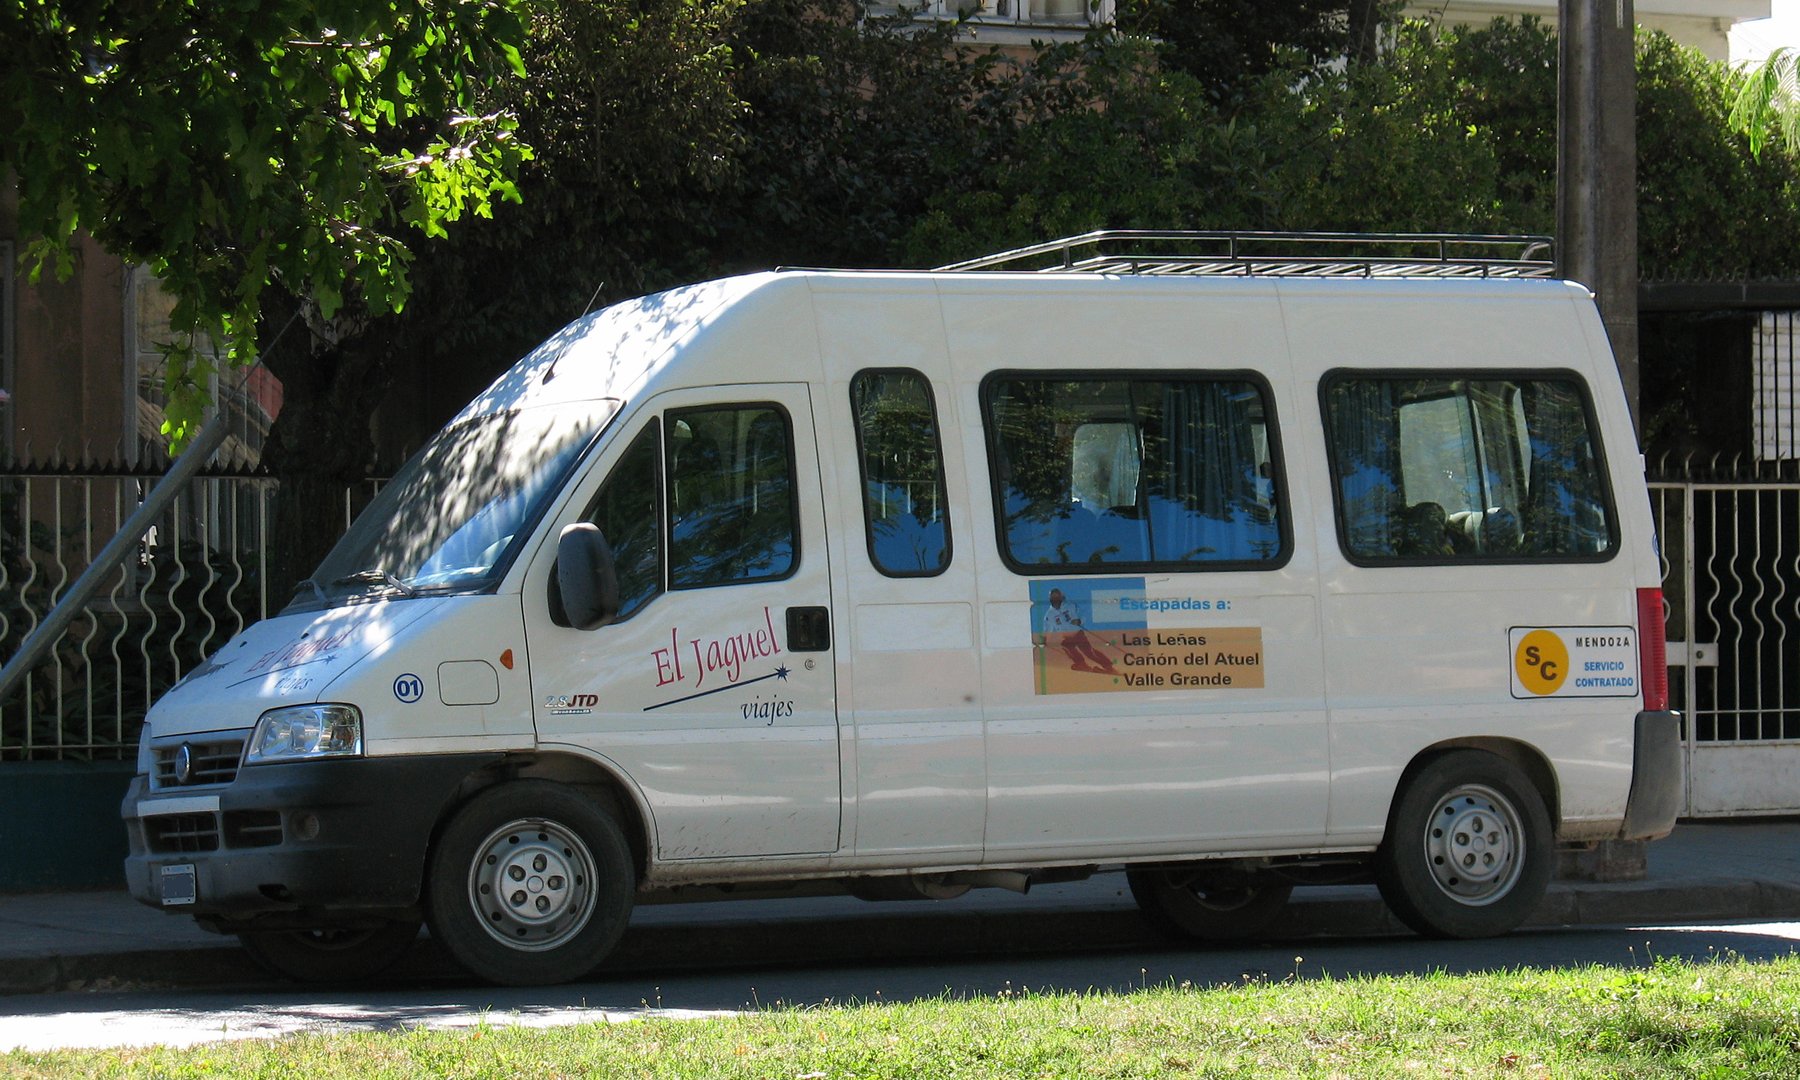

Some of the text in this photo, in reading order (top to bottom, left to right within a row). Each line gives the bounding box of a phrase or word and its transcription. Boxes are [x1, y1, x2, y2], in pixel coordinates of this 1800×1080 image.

[1119, 597, 1231, 612] Escapadas a:
[1122, 633, 1207, 646] Las Leñas
[1576, 637, 1630, 647] MENDOZA
[651, 606, 781, 688] El Jaguel
[1123, 652, 1259, 666] Cañón del Atuel
[1584, 661, 1625, 672] SERVICIO
[1124, 672, 1232, 686] Valle Grande
[1575, 677, 1634, 688] CONTRATADO
[397, 680, 419, 697] 01
[741, 694, 794, 726] viajes
